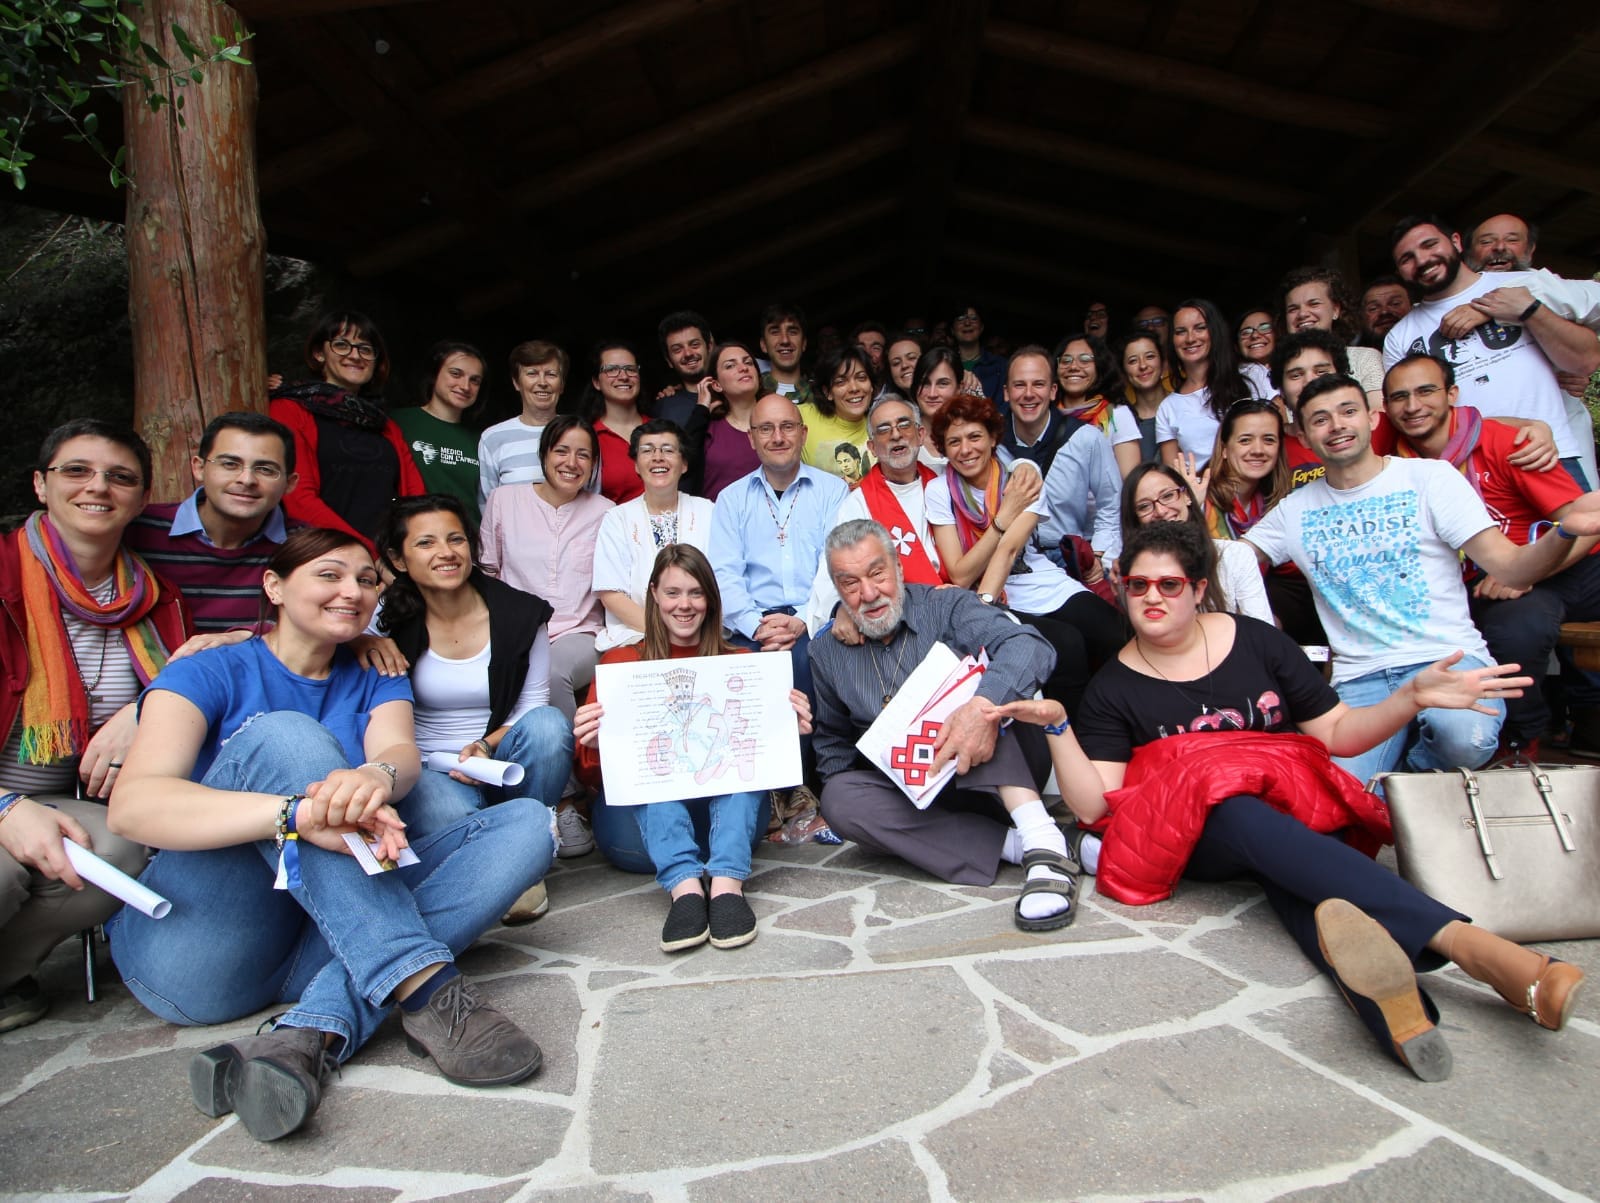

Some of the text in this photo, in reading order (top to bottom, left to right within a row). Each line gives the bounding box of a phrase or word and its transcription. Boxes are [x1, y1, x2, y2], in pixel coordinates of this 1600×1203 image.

[440, 446, 463, 456] MEDICI
[440, 453, 454, 461] CON
[1303, 514, 1416, 545] PARADISE
